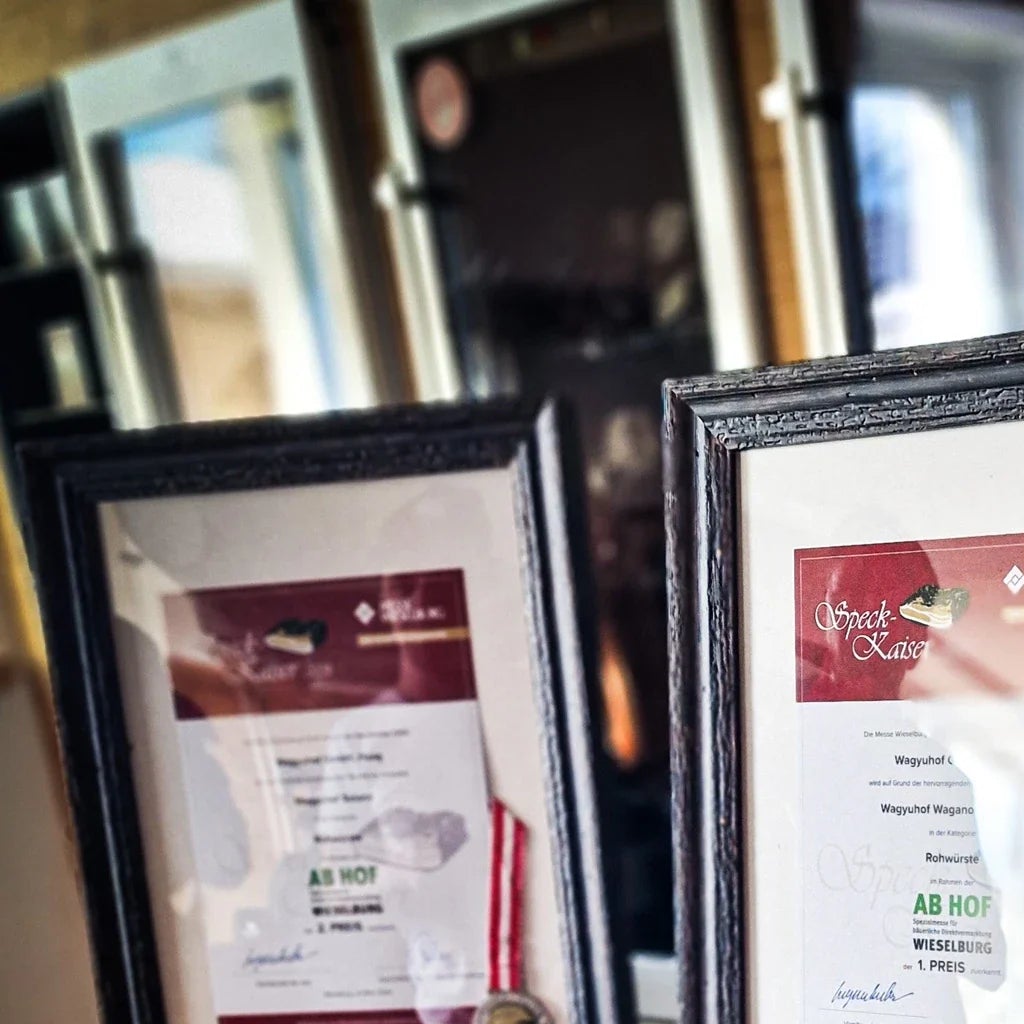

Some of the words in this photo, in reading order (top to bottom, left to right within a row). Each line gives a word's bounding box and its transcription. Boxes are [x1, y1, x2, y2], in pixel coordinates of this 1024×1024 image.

[815, 600, 897, 639] Speck-
[894, 754, 945, 768] Wagyuhof
[880, 803, 930, 816] Wagyuhof
[925, 851, 980, 865] Rohwürste
[914, 893, 943, 916] AB
[948, 894, 992, 918] HOF
[912, 938, 992, 955] WIESELBURG
[917, 959, 926, 971] 1.
[929, 959, 966, 974] PREIS
